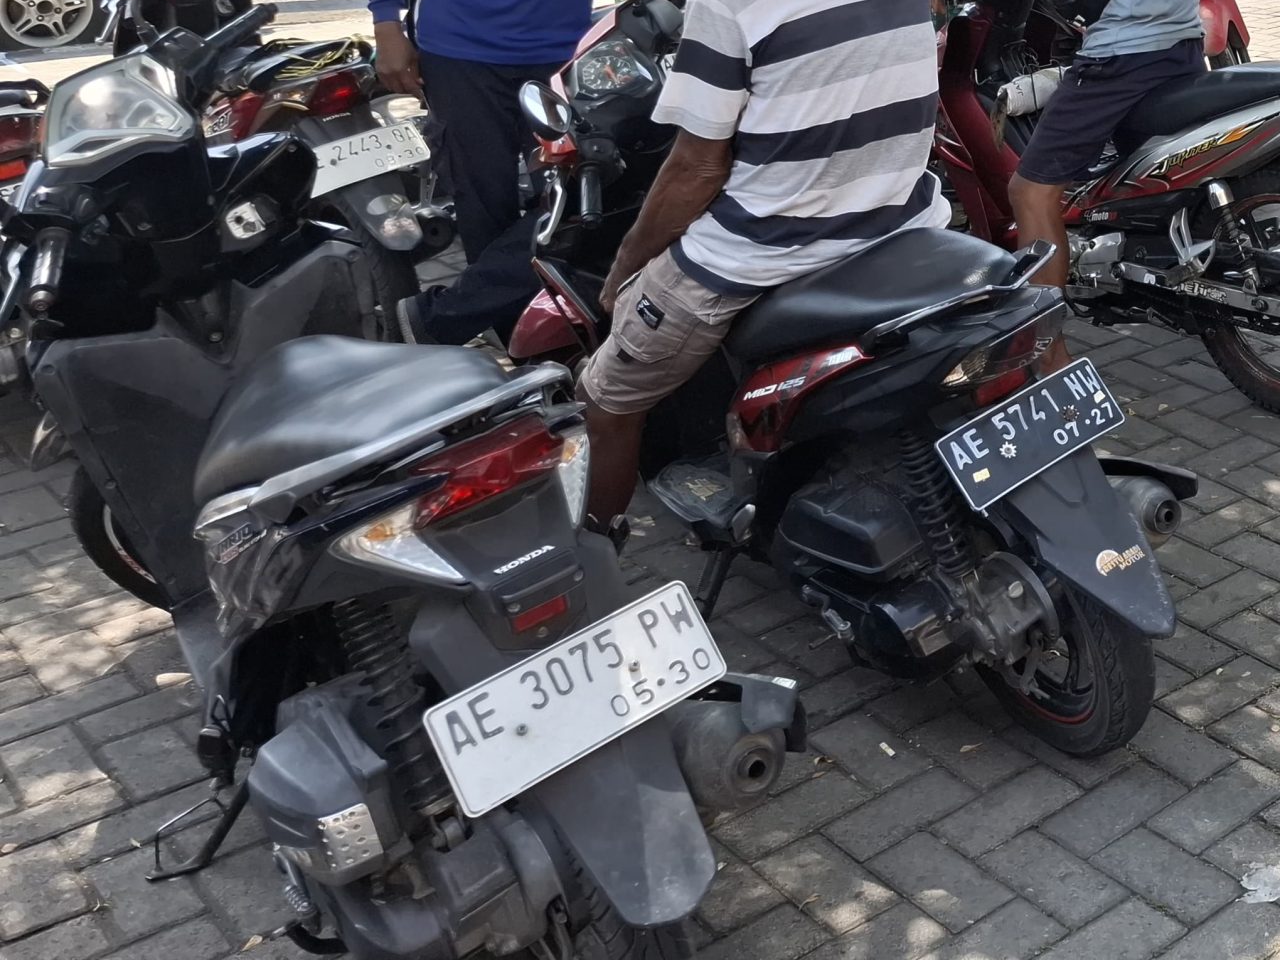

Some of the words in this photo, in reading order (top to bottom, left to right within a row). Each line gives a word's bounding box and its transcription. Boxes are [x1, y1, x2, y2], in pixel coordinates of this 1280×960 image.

[332, 134, 383, 161] 2443
[949, 428, 989, 470] AE
[991, 389, 1060, 440] 5741
[1063, 365, 1102, 401] NW
[493, 544, 556, 575] HONDA
[444, 691, 504, 757] AE
[519, 628, 625, 711] 3075
[637, 592, 695, 649] PW
